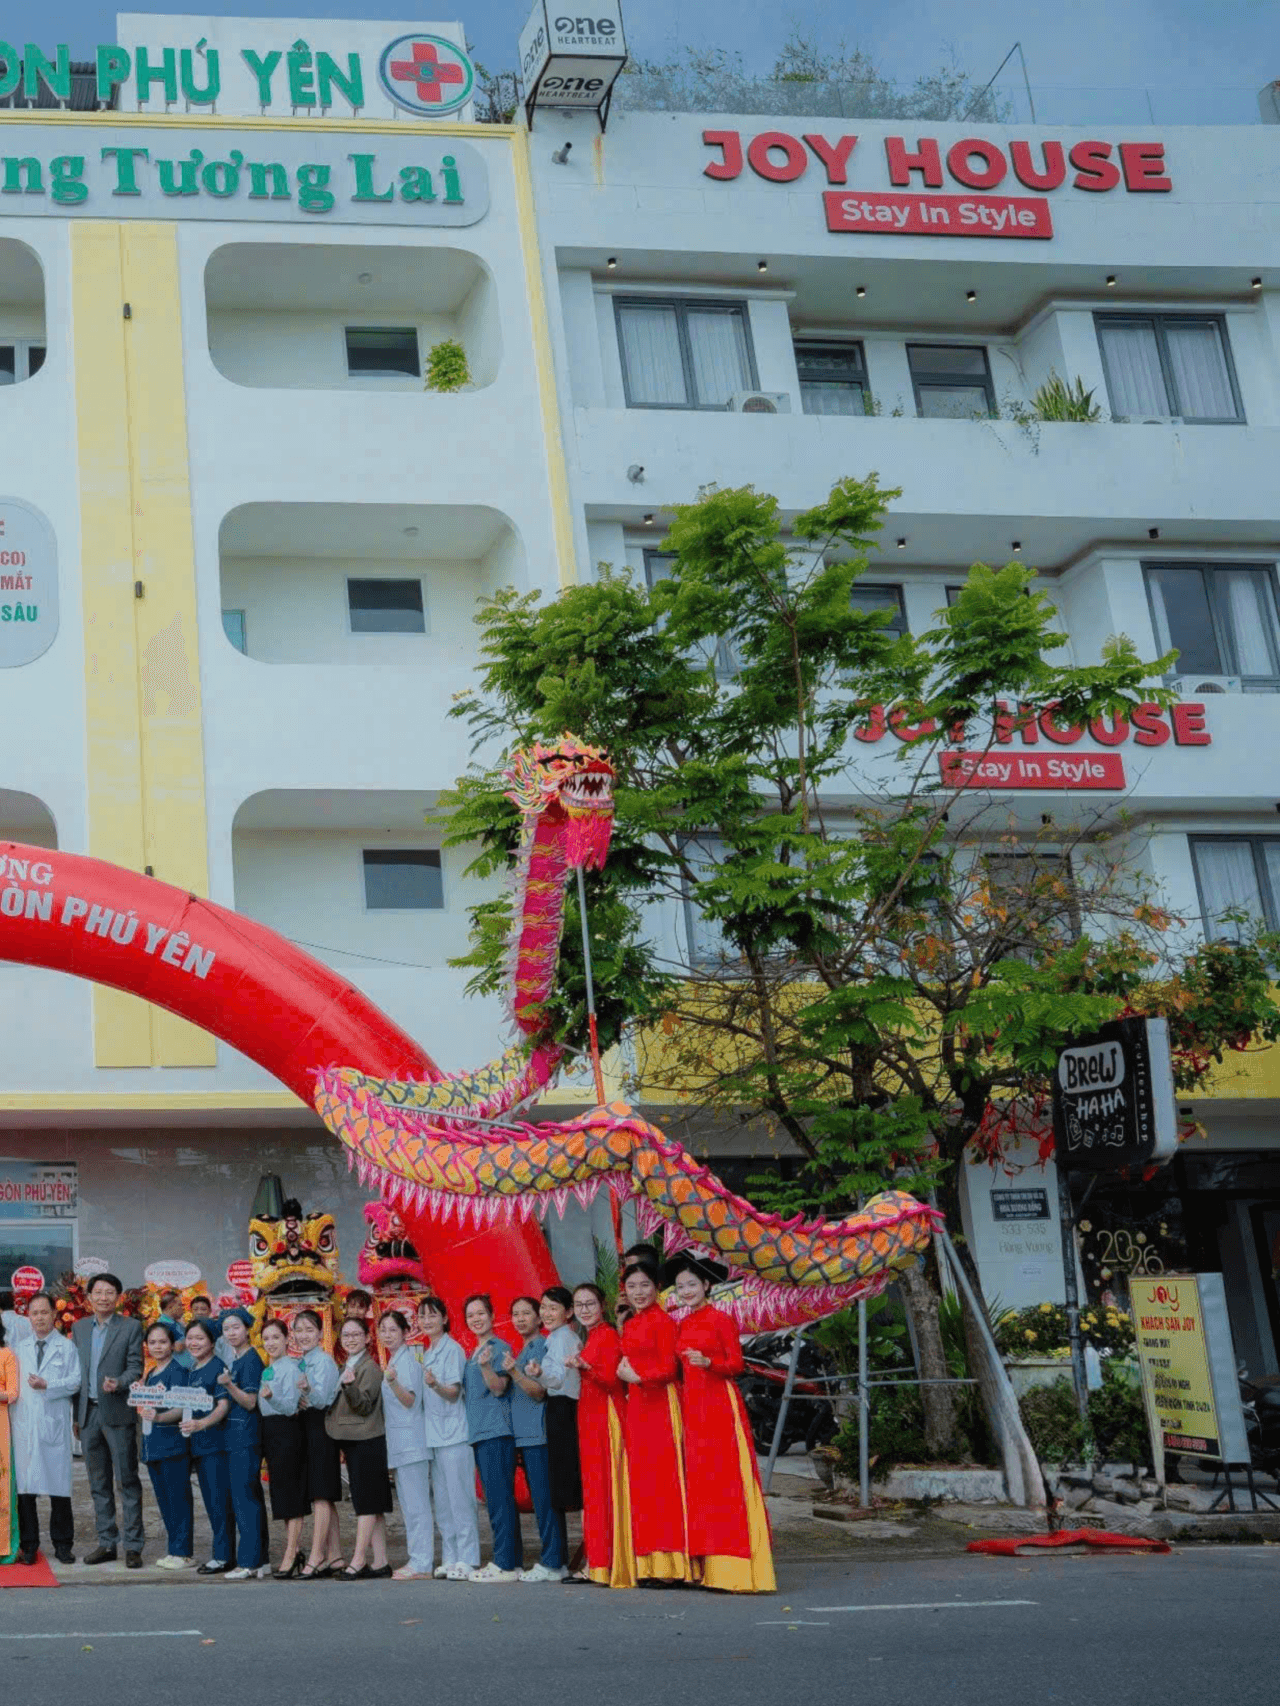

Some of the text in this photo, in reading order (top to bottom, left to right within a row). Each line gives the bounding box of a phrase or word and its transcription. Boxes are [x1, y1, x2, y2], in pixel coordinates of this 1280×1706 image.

[557, 36, 616, 45] HEARTBEAT
[96, 37, 221, 106] PHÚ
[239, 39, 366, 110] YÊN
[538, 91, 598, 99] HEARTBEAT
[703, 130, 1173, 193] JOY HOUSE
[101, 146, 336, 214] Tương
[347, 155, 465, 205] Lai
[841, 200, 1037, 231] Stay In Style
[0, 570, 33, 591] MẮT
[0, 601, 38, 623] SÂU
[960, 759, 1106, 782] Stay In Style
[61, 896, 141, 944] PHÚ
[142, 920, 216, 980] YÊN
[1076, 1088, 1125, 1121] HAHA
[25, 1177, 47, 1202] PHÚ
[49, 1177, 71, 1202] YÊN
[1182, 1316, 1195, 1331] JOY
